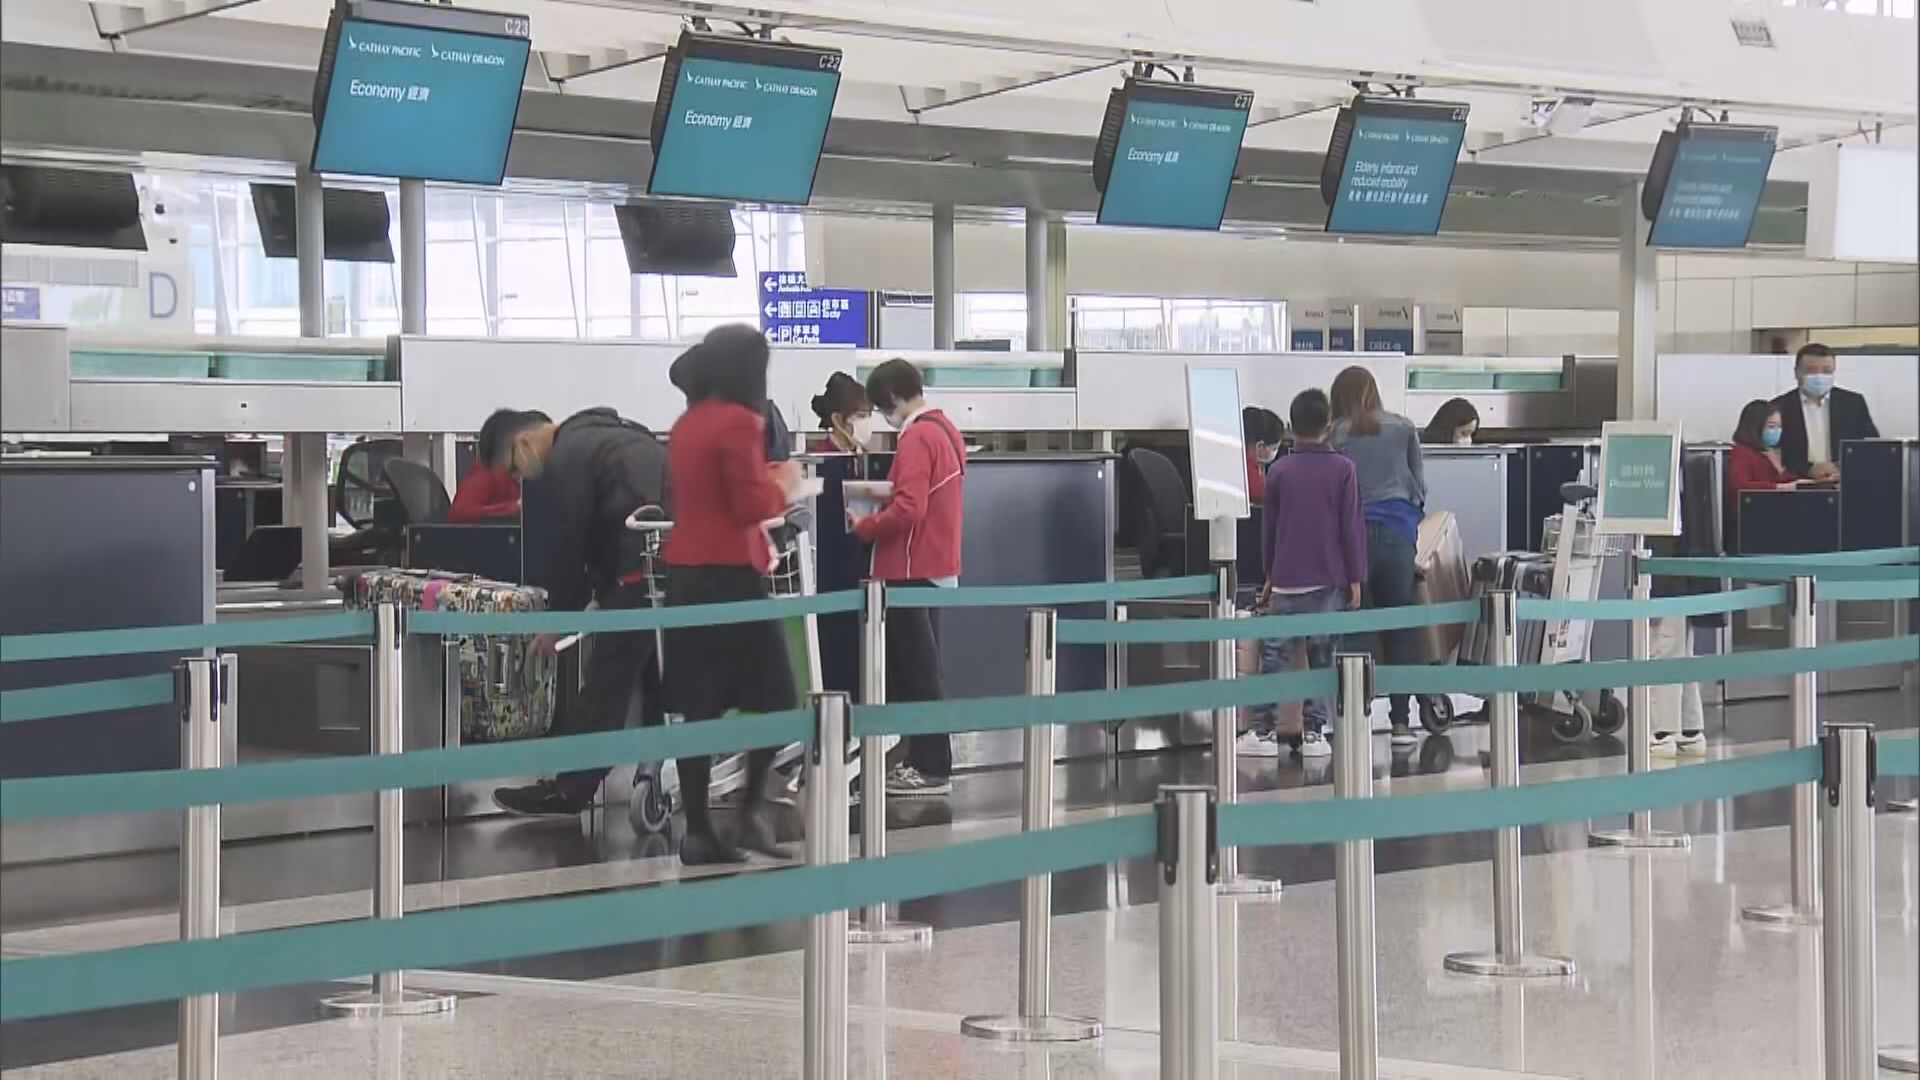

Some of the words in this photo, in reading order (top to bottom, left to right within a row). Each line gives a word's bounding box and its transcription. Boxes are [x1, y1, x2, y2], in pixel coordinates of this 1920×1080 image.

[504, 18, 529, 36] C23
[358, 41, 392, 55] CATHAY
[392, 44, 422, 58] PACIFIC
[440, 50, 472, 64] CATHAY
[472, 53, 505, 67] DRAGON
[694, 74, 722, 87] CATHAY
[721, 77, 748, 90] PACIFIC
[763, 82, 790, 95] CATHAY
[789, 85, 818, 97] DRAGON
[350, 79, 407, 103] Economy
[684, 109, 732, 130] Economy
[1127, 146, 1165, 166] Economy
[1350, 175, 1381, 187] reduced
[149, 271, 178, 319] D
